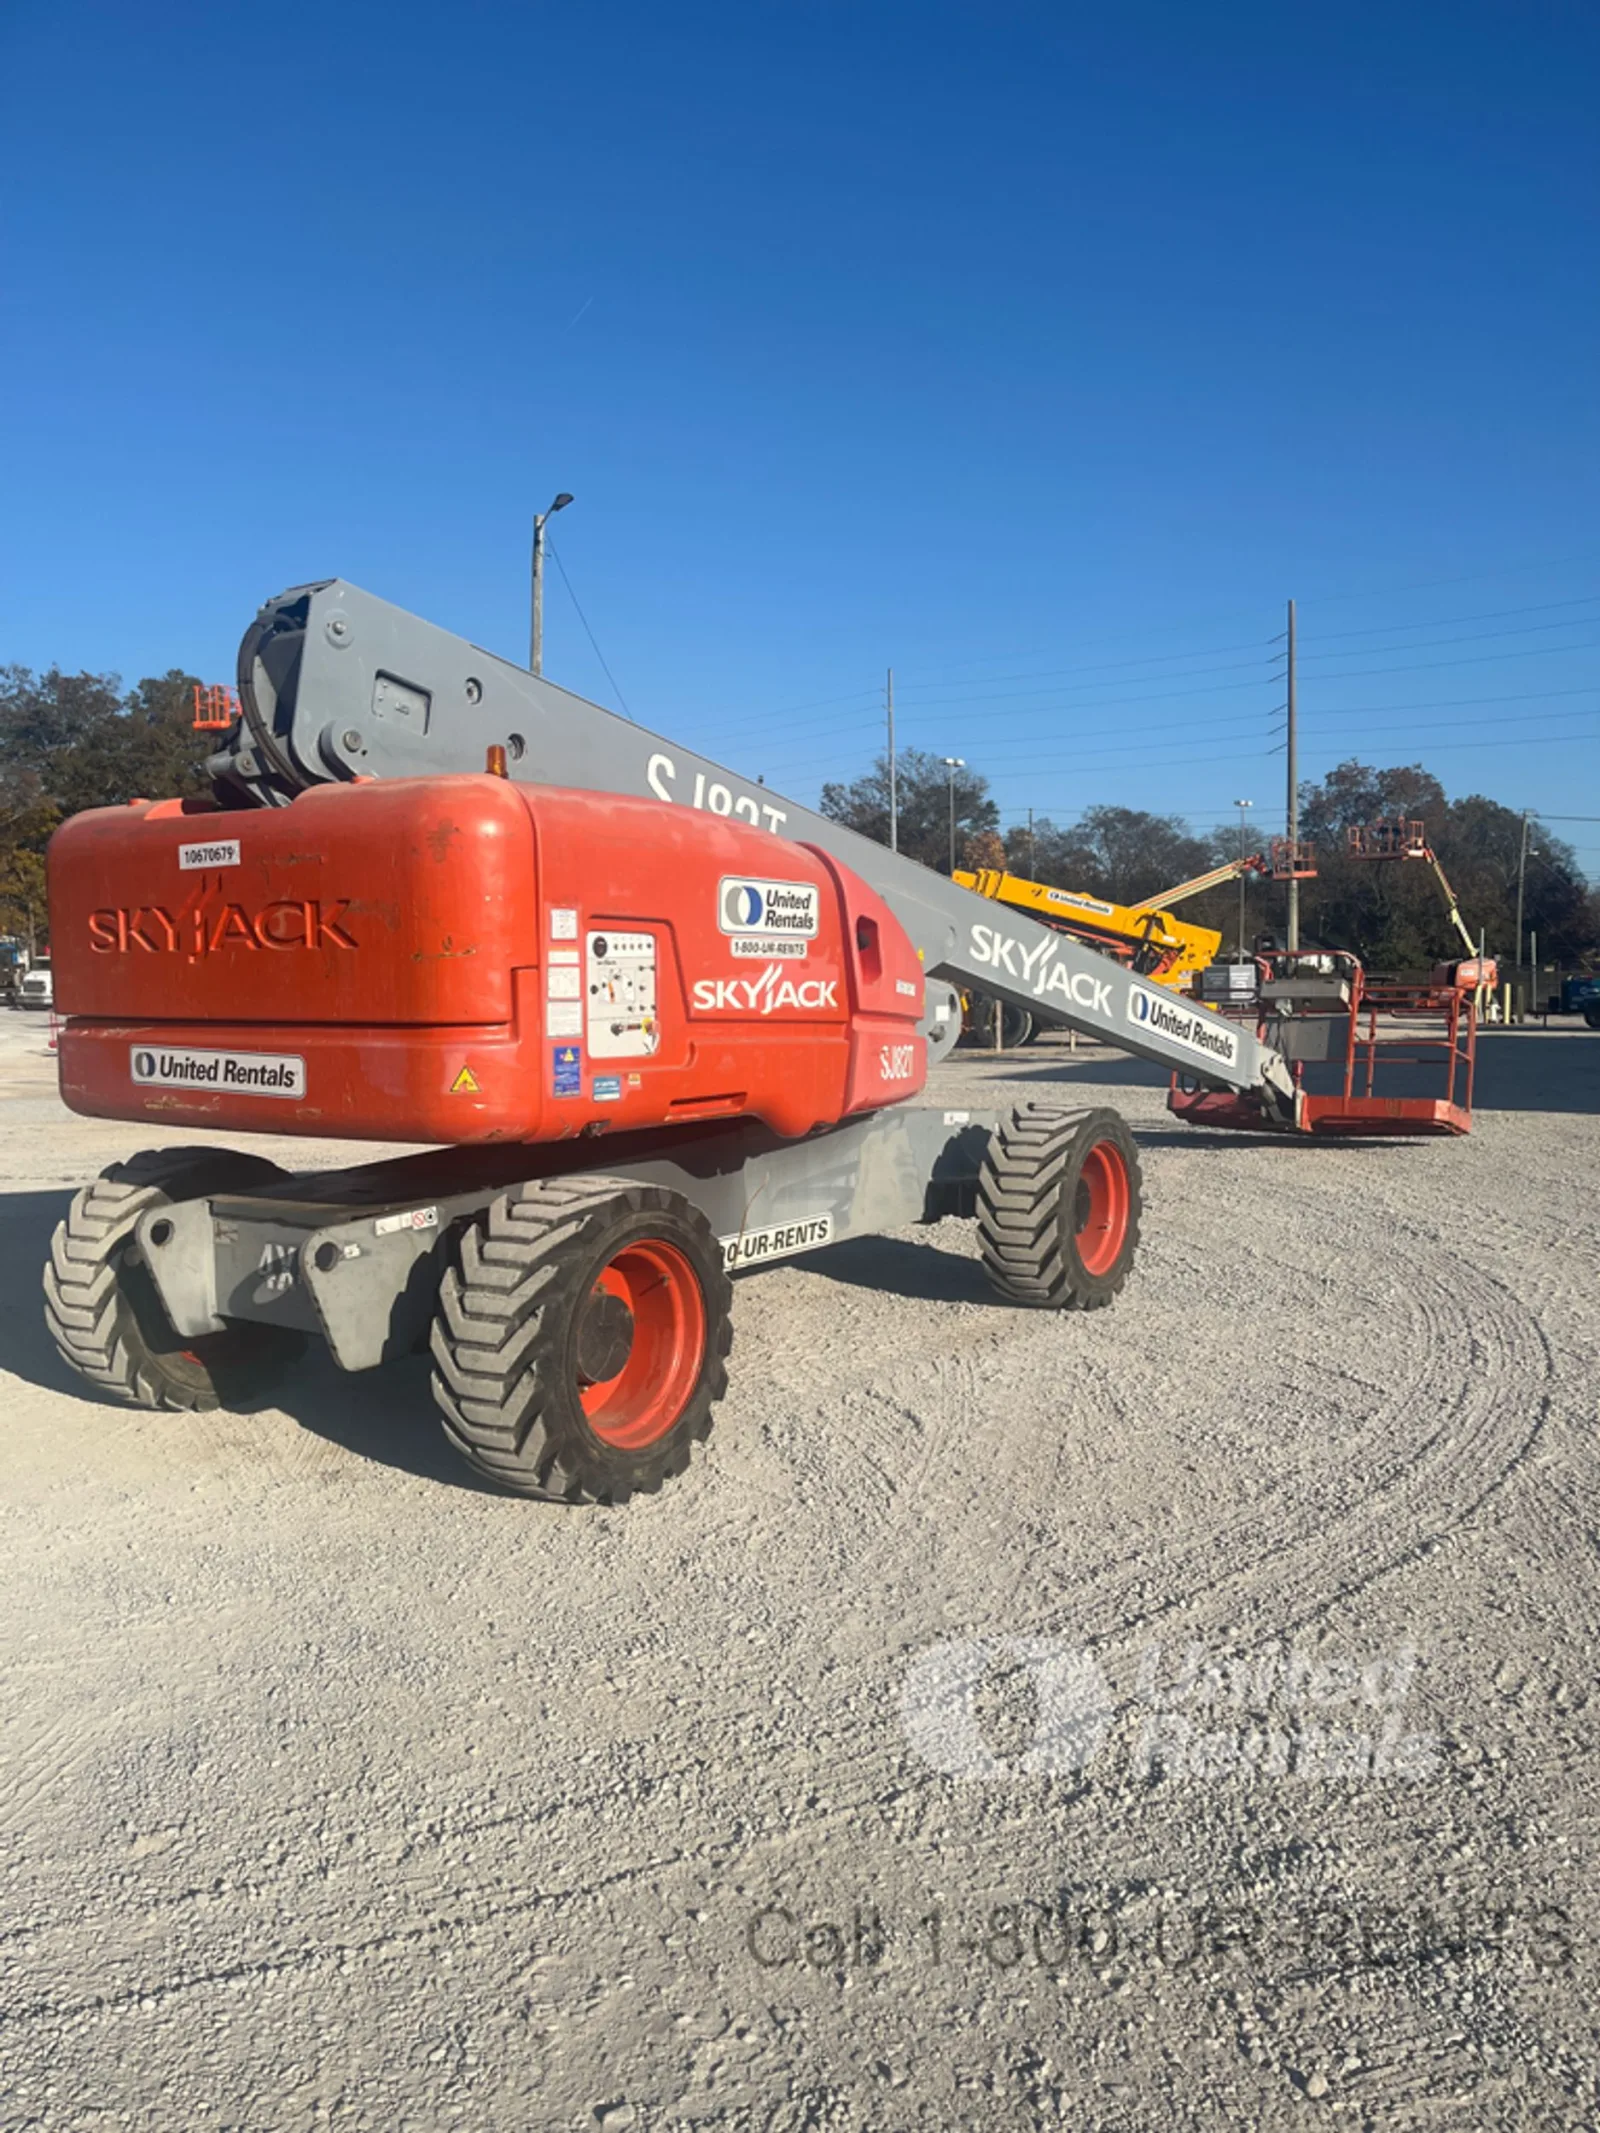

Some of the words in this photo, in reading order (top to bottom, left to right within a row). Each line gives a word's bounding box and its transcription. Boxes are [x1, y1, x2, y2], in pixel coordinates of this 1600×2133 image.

[184, 845, 233, 864] 10670679
[88, 873, 359, 965] SKYJACK
[764, 909, 814, 930] Rentals
[765, 888, 811, 910] United
[692, 962, 838, 1015] SKYJACK
[969, 924, 1113, 1018] SKYJACK
[1150, 1001, 1193, 1041] United
[1191, 1021, 1234, 1060] Rentals
[159, 1054, 219, 1083] United
[222, 1059, 296, 1088] Rentals
